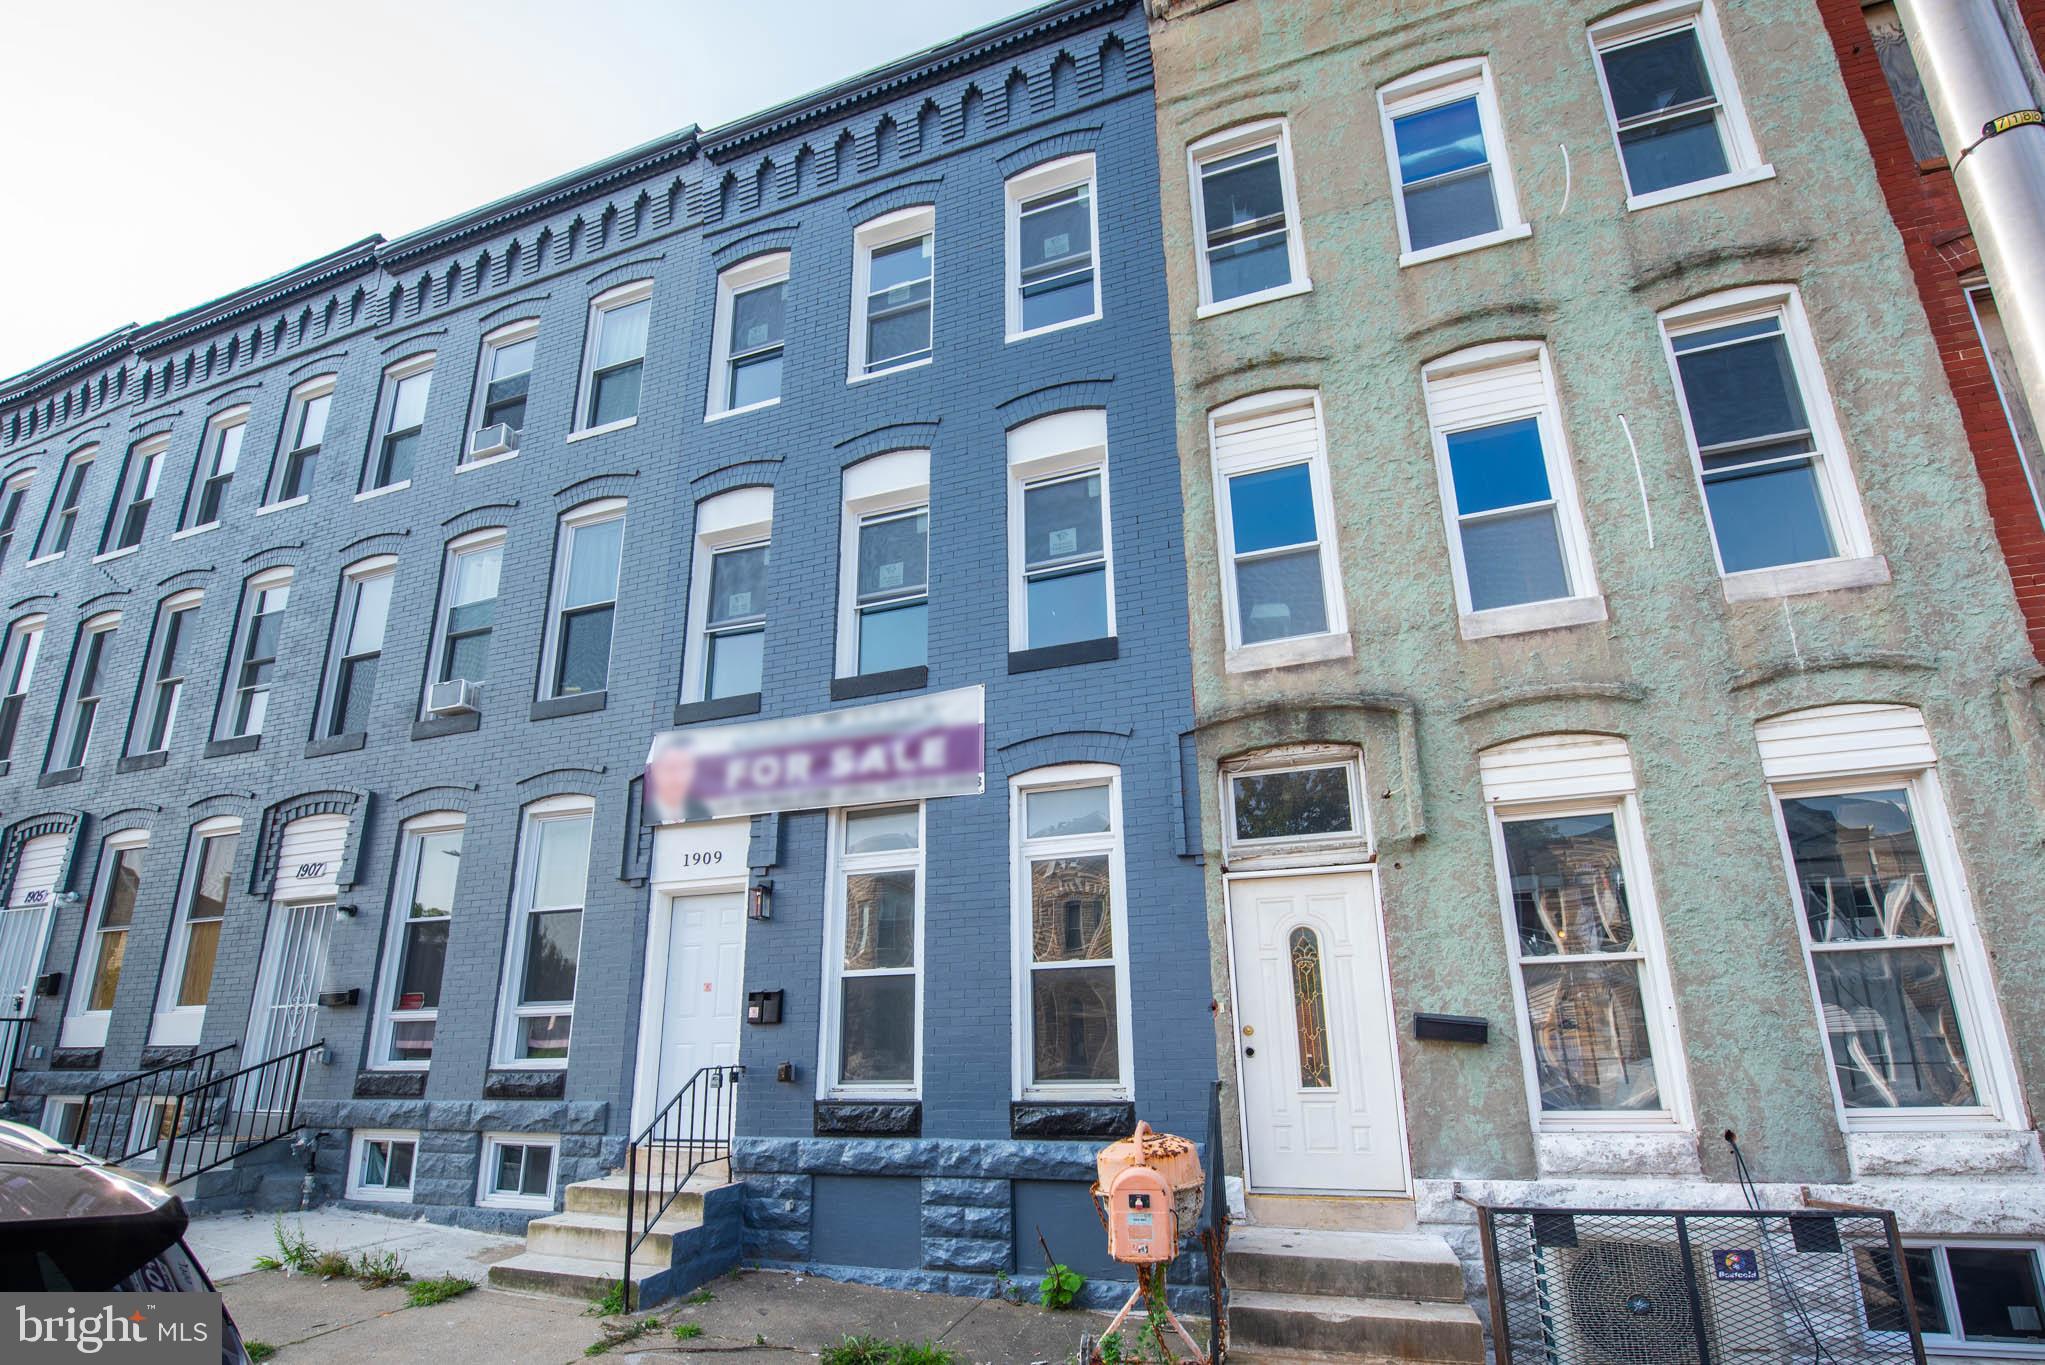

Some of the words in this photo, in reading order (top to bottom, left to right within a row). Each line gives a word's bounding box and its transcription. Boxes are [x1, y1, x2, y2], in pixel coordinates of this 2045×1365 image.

[725, 752, 811, 789] FOR
[829, 736, 948, 777] SALE
[683, 850, 723, 867] 1909
[295, 862, 325, 878] 1907
[24, 890, 46, 904] 1905
